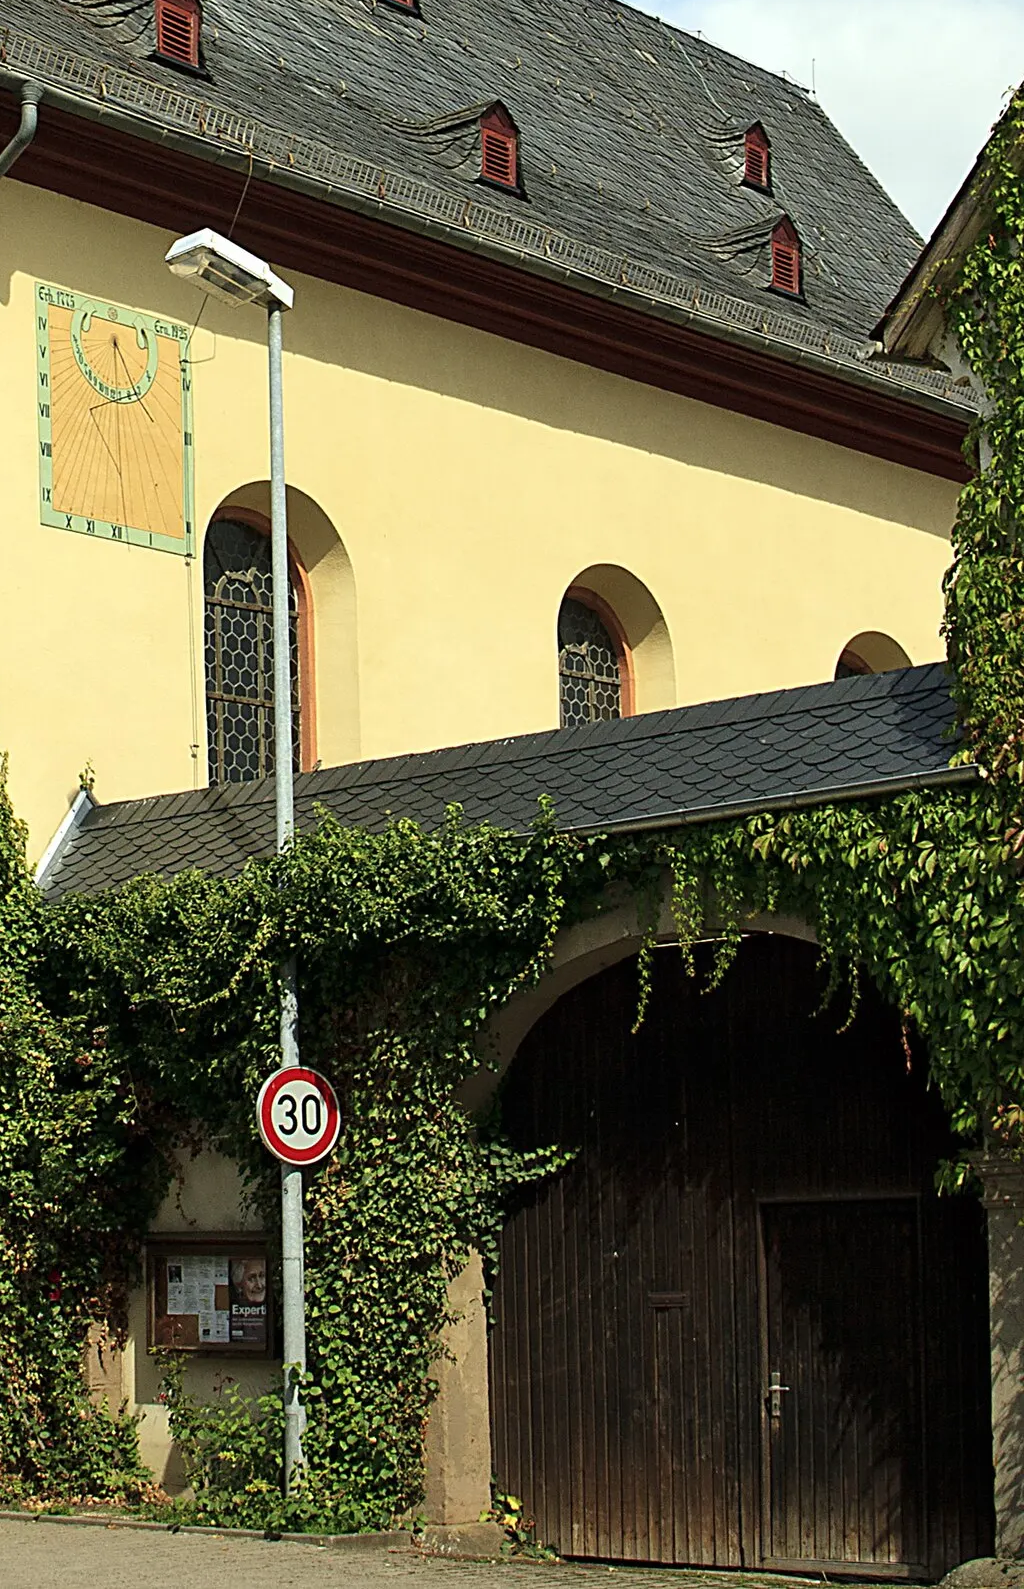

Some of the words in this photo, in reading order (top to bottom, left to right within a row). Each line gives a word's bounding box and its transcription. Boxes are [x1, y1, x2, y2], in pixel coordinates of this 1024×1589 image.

[56, 291, 75, 308] 1775
[38, 316, 47, 330] IV
[39, 345, 47, 358] V
[39, 372, 48, 387] VI
[39, 402, 50, 418] VII
[43, 487, 51, 503] IX
[66, 515, 73, 528] X
[86, 519, 95, 533] XI
[111, 524, 123, 539] XII
[278, 1094, 321, 1135] 30
